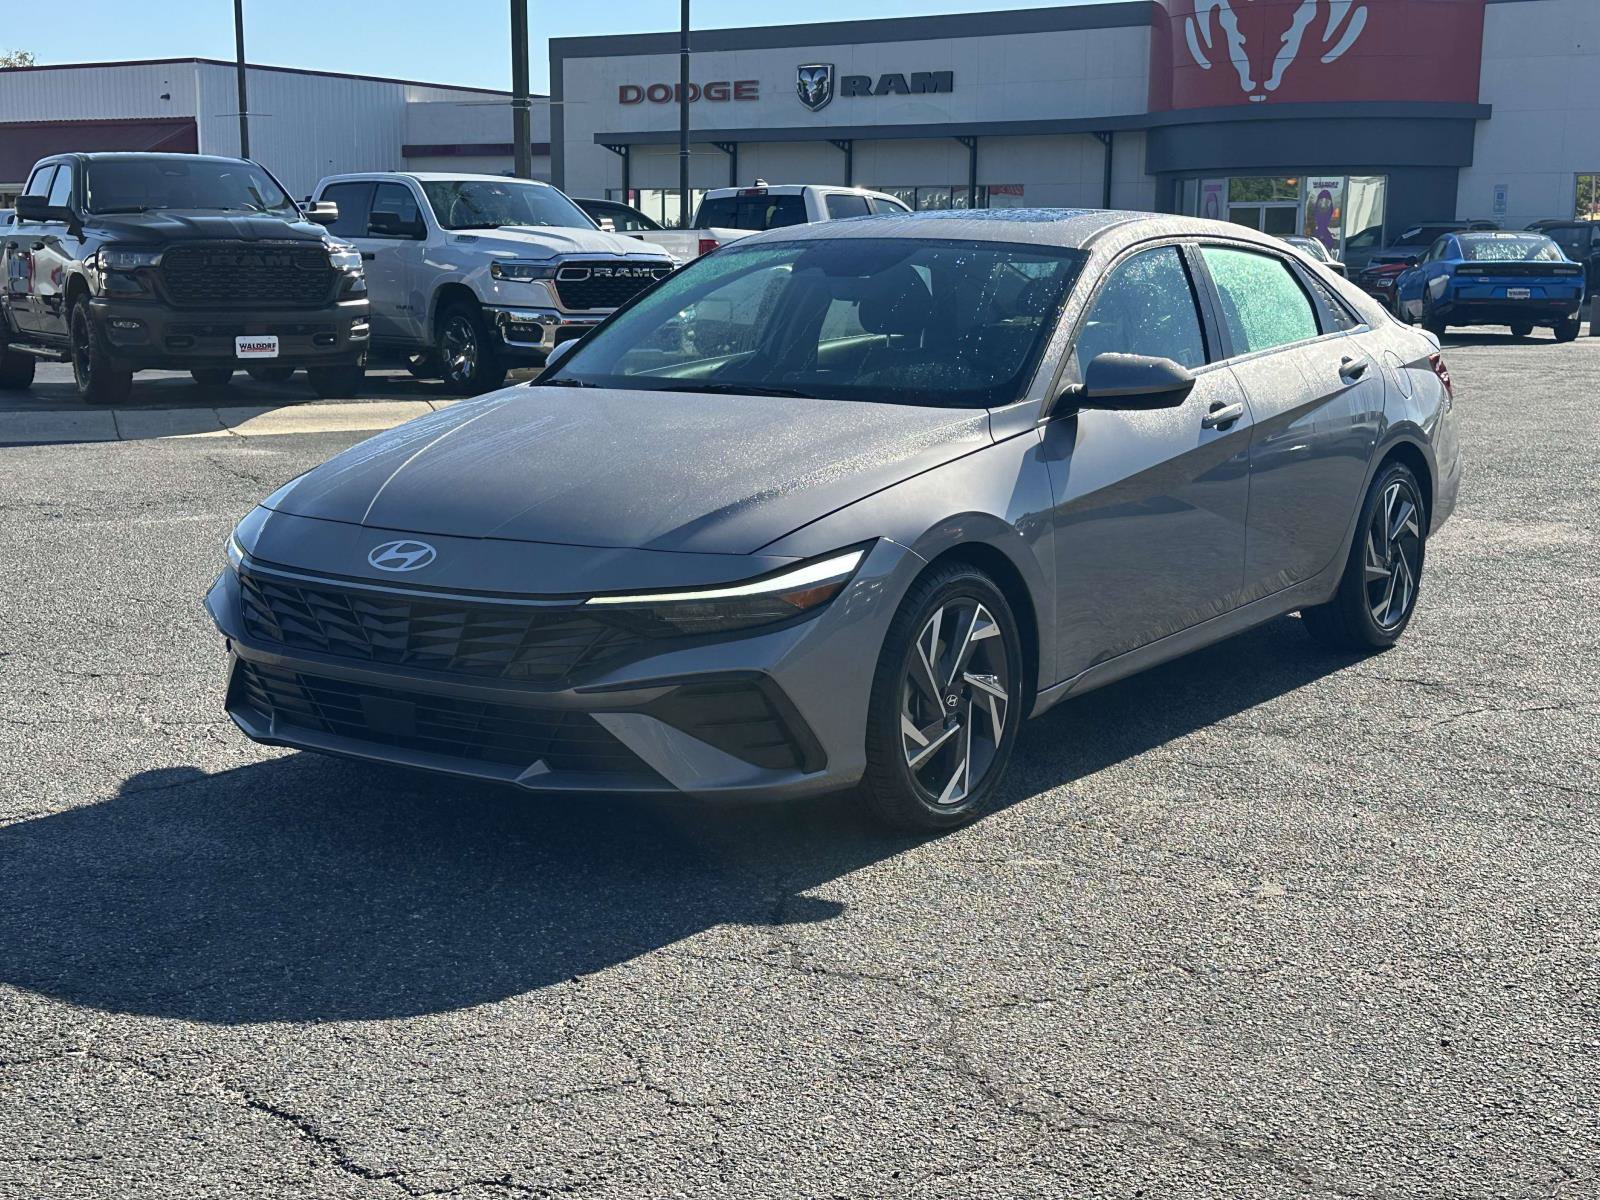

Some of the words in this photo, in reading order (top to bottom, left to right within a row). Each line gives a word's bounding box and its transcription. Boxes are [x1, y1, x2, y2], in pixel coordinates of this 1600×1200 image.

[619, 80, 760, 104] DODGE
[841, 71, 954, 96] RAM
[594, 267, 650, 278] RAM
